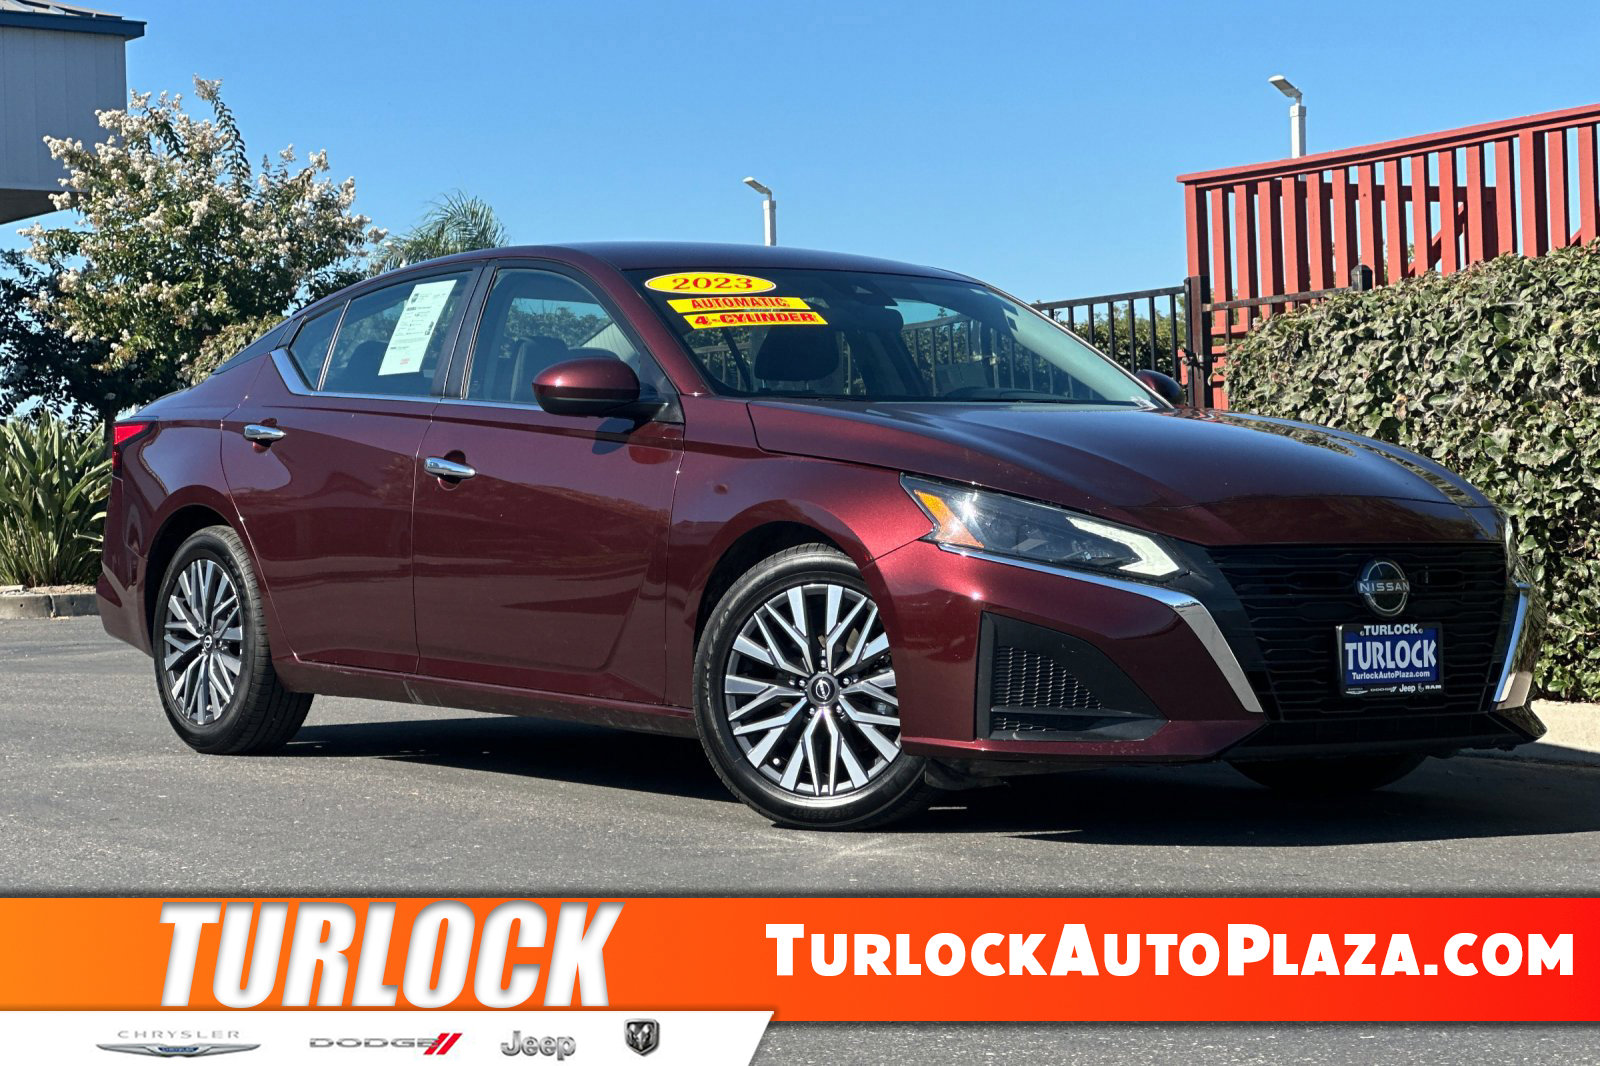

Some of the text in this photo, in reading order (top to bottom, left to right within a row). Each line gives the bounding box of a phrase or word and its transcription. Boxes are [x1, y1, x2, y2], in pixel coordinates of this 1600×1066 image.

[672, 277, 752, 290] 2023
[691, 297, 790, 310] AUTOMATIC
[695, 312, 817, 325] 4-CYLINDER
[1359, 581, 1410, 592] NISSAN
[1363, 624, 1419, 636] TURLOCK
[1345, 640, 1437, 670] TURLOCK
[1352, 671, 1430, 680] TurlockAutoPlaza.com
[1399, 683, 1416, 693] Jeep
